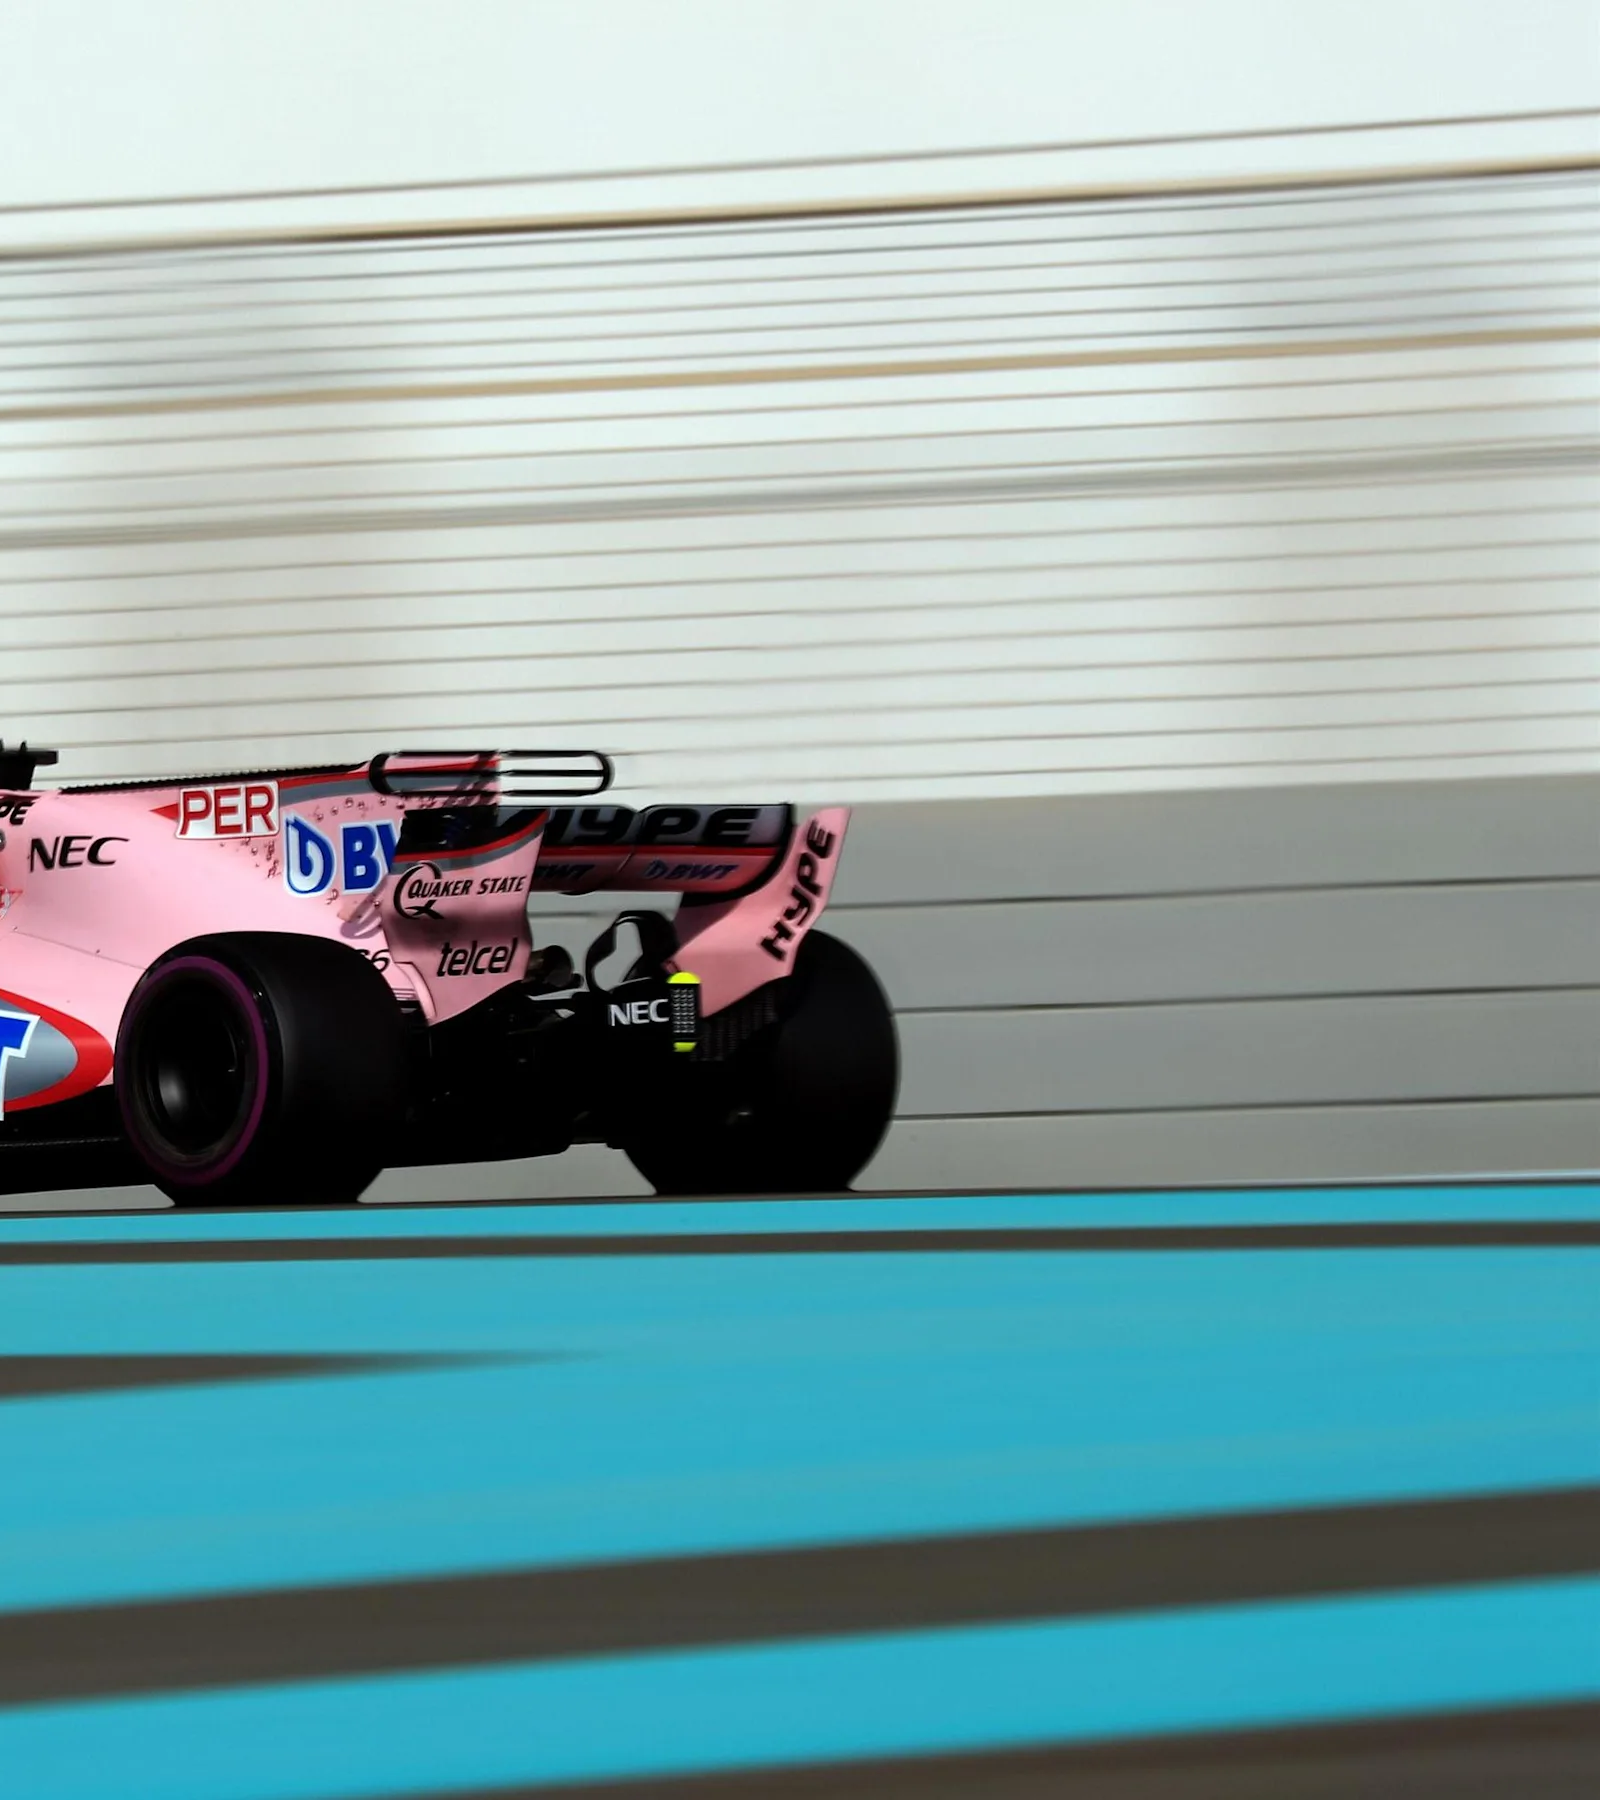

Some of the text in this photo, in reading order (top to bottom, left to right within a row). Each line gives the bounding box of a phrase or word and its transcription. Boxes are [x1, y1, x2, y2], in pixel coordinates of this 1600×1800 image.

[179, 784, 276, 835] PER
[28, 835, 130, 873] NEC
[664, 863, 740, 881] BWT
[407, 875, 527, 899] QUAKER STATE
[759, 819, 837, 962] HYPE
[436, 937, 519, 977] telcel
[608, 998, 670, 1027] NEC
